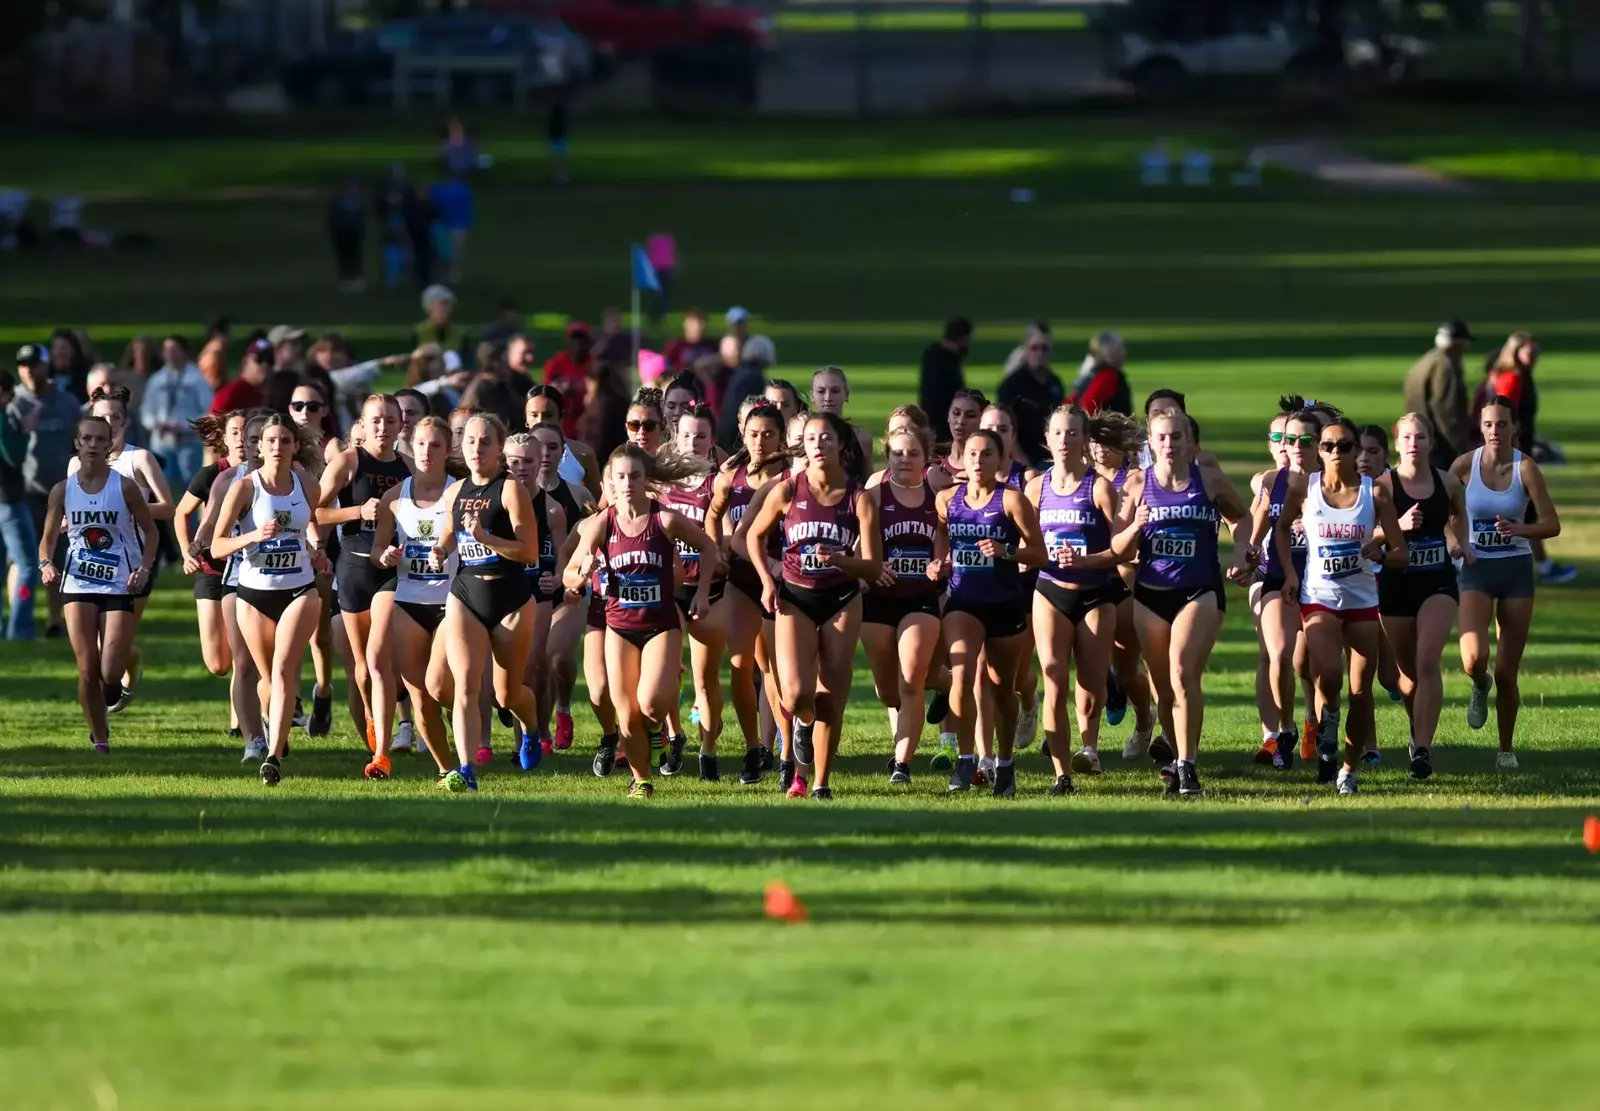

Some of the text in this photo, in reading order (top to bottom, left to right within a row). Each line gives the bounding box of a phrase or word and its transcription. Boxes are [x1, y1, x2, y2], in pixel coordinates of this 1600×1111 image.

[459, 498, 491, 510] TECH
[72, 511, 119, 525] UMW
[1318, 522, 1365, 540] DAWSON
[1155, 539, 1192, 556] 4626
[265, 552, 296, 568] 4727
[1324, 556, 1358, 572] 4642
[1411, 548, 1439, 565] 4741
[78, 561, 114, 581] 4685
[892, 559, 927, 573] 4645
[621, 587, 656, 602] 4651
